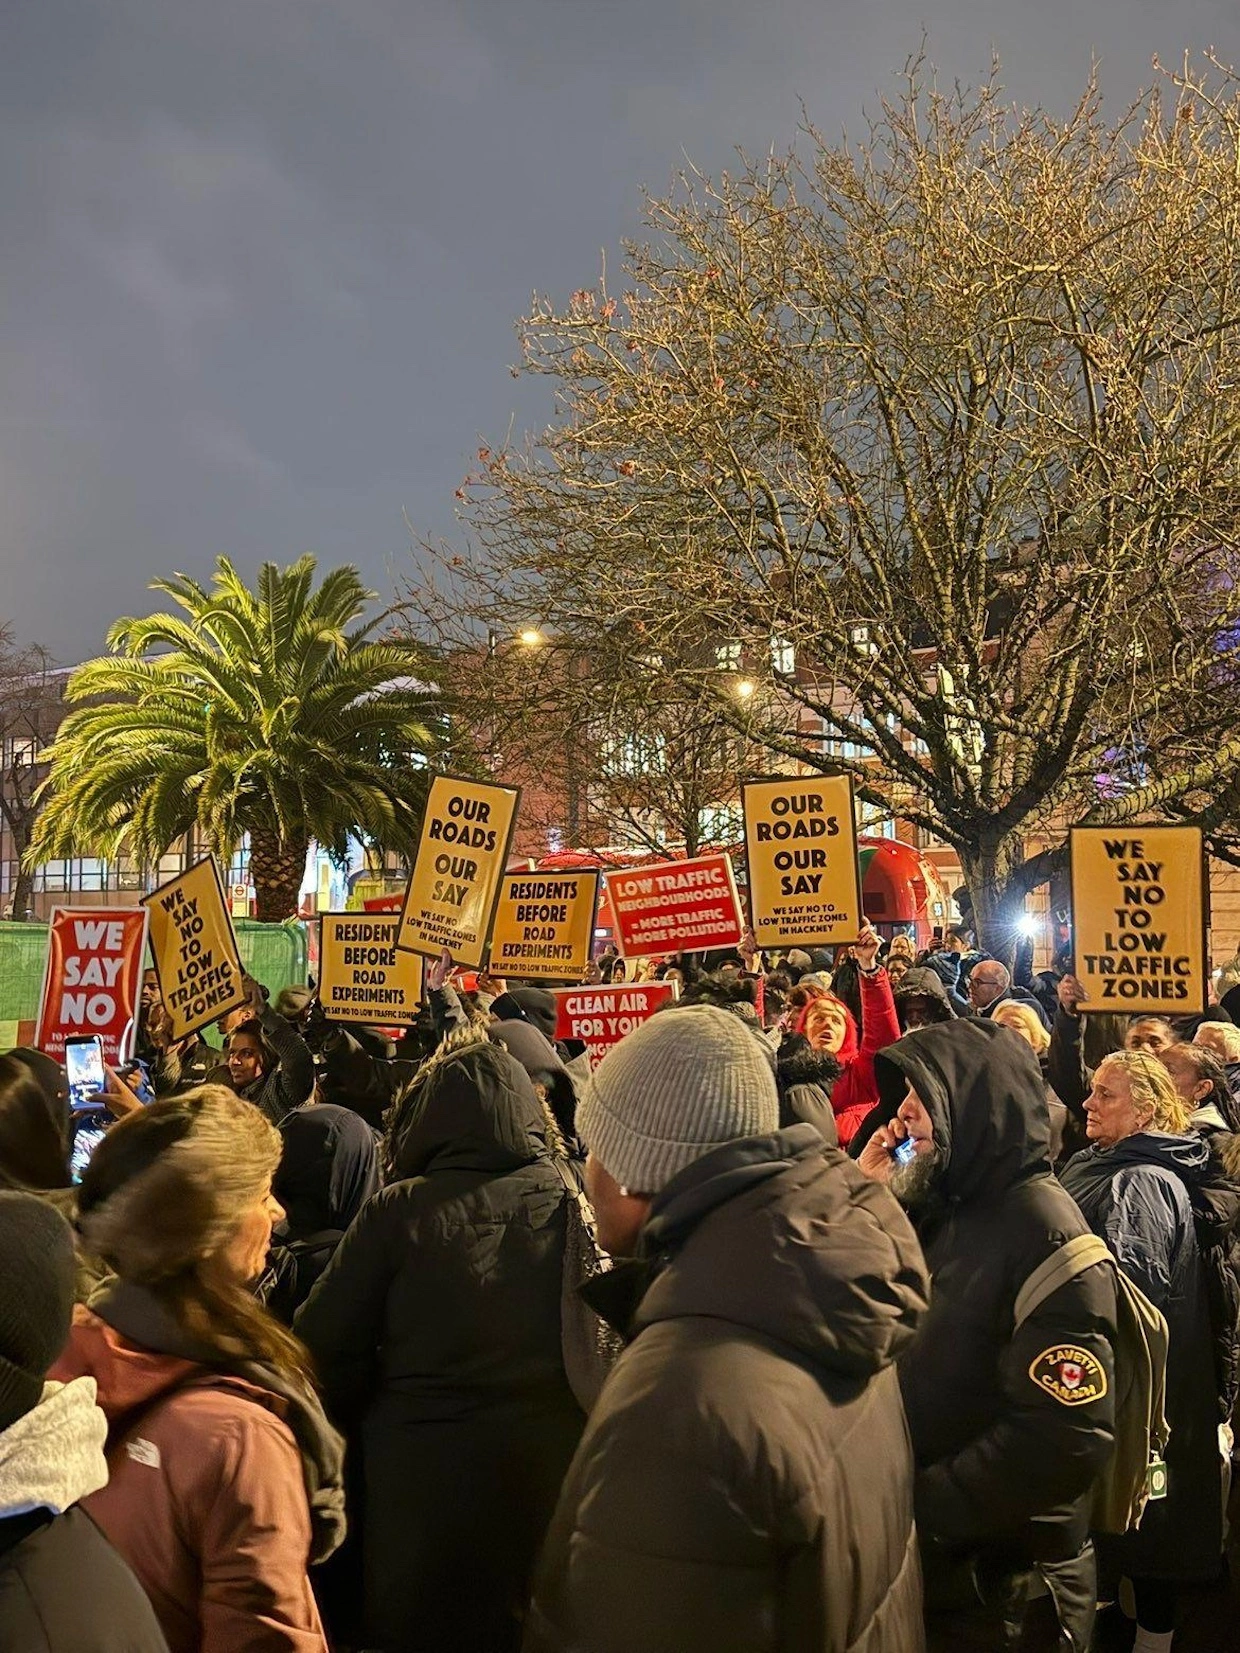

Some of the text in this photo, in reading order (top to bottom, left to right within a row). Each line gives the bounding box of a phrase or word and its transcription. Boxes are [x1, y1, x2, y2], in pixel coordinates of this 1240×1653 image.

[448, 796, 491, 823] OUR
[771, 795, 824, 816] OUR
[429, 819, 497, 852] ROADS
[756, 817, 839, 841] ROADS
[1102, 839, 1144, 859] WE
[435, 854, 478, 881] OUR
[774, 850, 827, 871] OUR
[616, 867, 724, 898] LOW TRAFFIC
[1117, 862, 1163, 882] SAY
[432, 881, 469, 907] SAY
[510, 881, 577, 900] RESIDENTS
[781, 874, 822, 895] SAY
[1124, 884, 1165, 905] NO
[161, 888, 185, 913] WE
[617, 886, 730, 913] NEIGHBOURHOODS
[773, 904, 834, 915] WE SAY NO TO
[173, 899, 198, 927] SAY
[421, 910, 457, 926] WE SAY NO
[517, 905, 567, 922] BEFORE
[640, 915, 675, 930] MORE
[677, 908, 725, 925] TRAFFIC
[759, 913, 848, 926] LOW TRAFFIC ZONES
[1115, 908, 1152, 928] TO
[74, 921, 124, 950] WE
[180, 917, 203, 939] NO
[335, 923, 399, 942] RESIDENT
[406, 917, 476, 943] LOW TRAFFIC ZONES
[523, 926, 555, 941] ROAD
[633, 930, 668, 945] MORE
[668, 920, 737, 939] POLLUTION
[779, 924, 833, 935] IN HACKNEY
[180, 942, 200, 961] TO
[420, 932, 463, 950] IN HACKNEY
[502, 943, 573, 960] EXPERIMENTS
[1105, 932, 1166, 952] LOW
[344, 947, 396, 966] BEFORE
[1083, 955, 1190, 976] TRAFFIC
[63, 957, 124, 987] SAY
[177, 950, 212, 985] LOW
[353, 970, 386, 985] ROAD
[510, 963, 518, 971] NO
[520, 963, 526, 971] TO
[527, 964, 540, 972] LOW
[541, 965, 563, 973] TRAFFIC
[168, 961, 232, 1010] TRAFFIC
[332, 986, 404, 1005] EXPERIMENTS
[1102, 979, 1188, 999] ZONES
[60, 993, 116, 1026] NO
[183, 981, 235, 1022] ZONES
[566, 993, 649, 1016] CLEAN AIR
[331, 1007, 341, 1015] SAY
[351, 1008, 359, 1016] TO
[360, 1009, 373, 1017] LOW
[374, 1009, 397, 1018] TRAFFIC
[572, 1018, 605, 1037] FOR
[1045, 1349, 1098, 1375] ZAVETTI
[1042, 1374, 1097, 1400] CANADA
